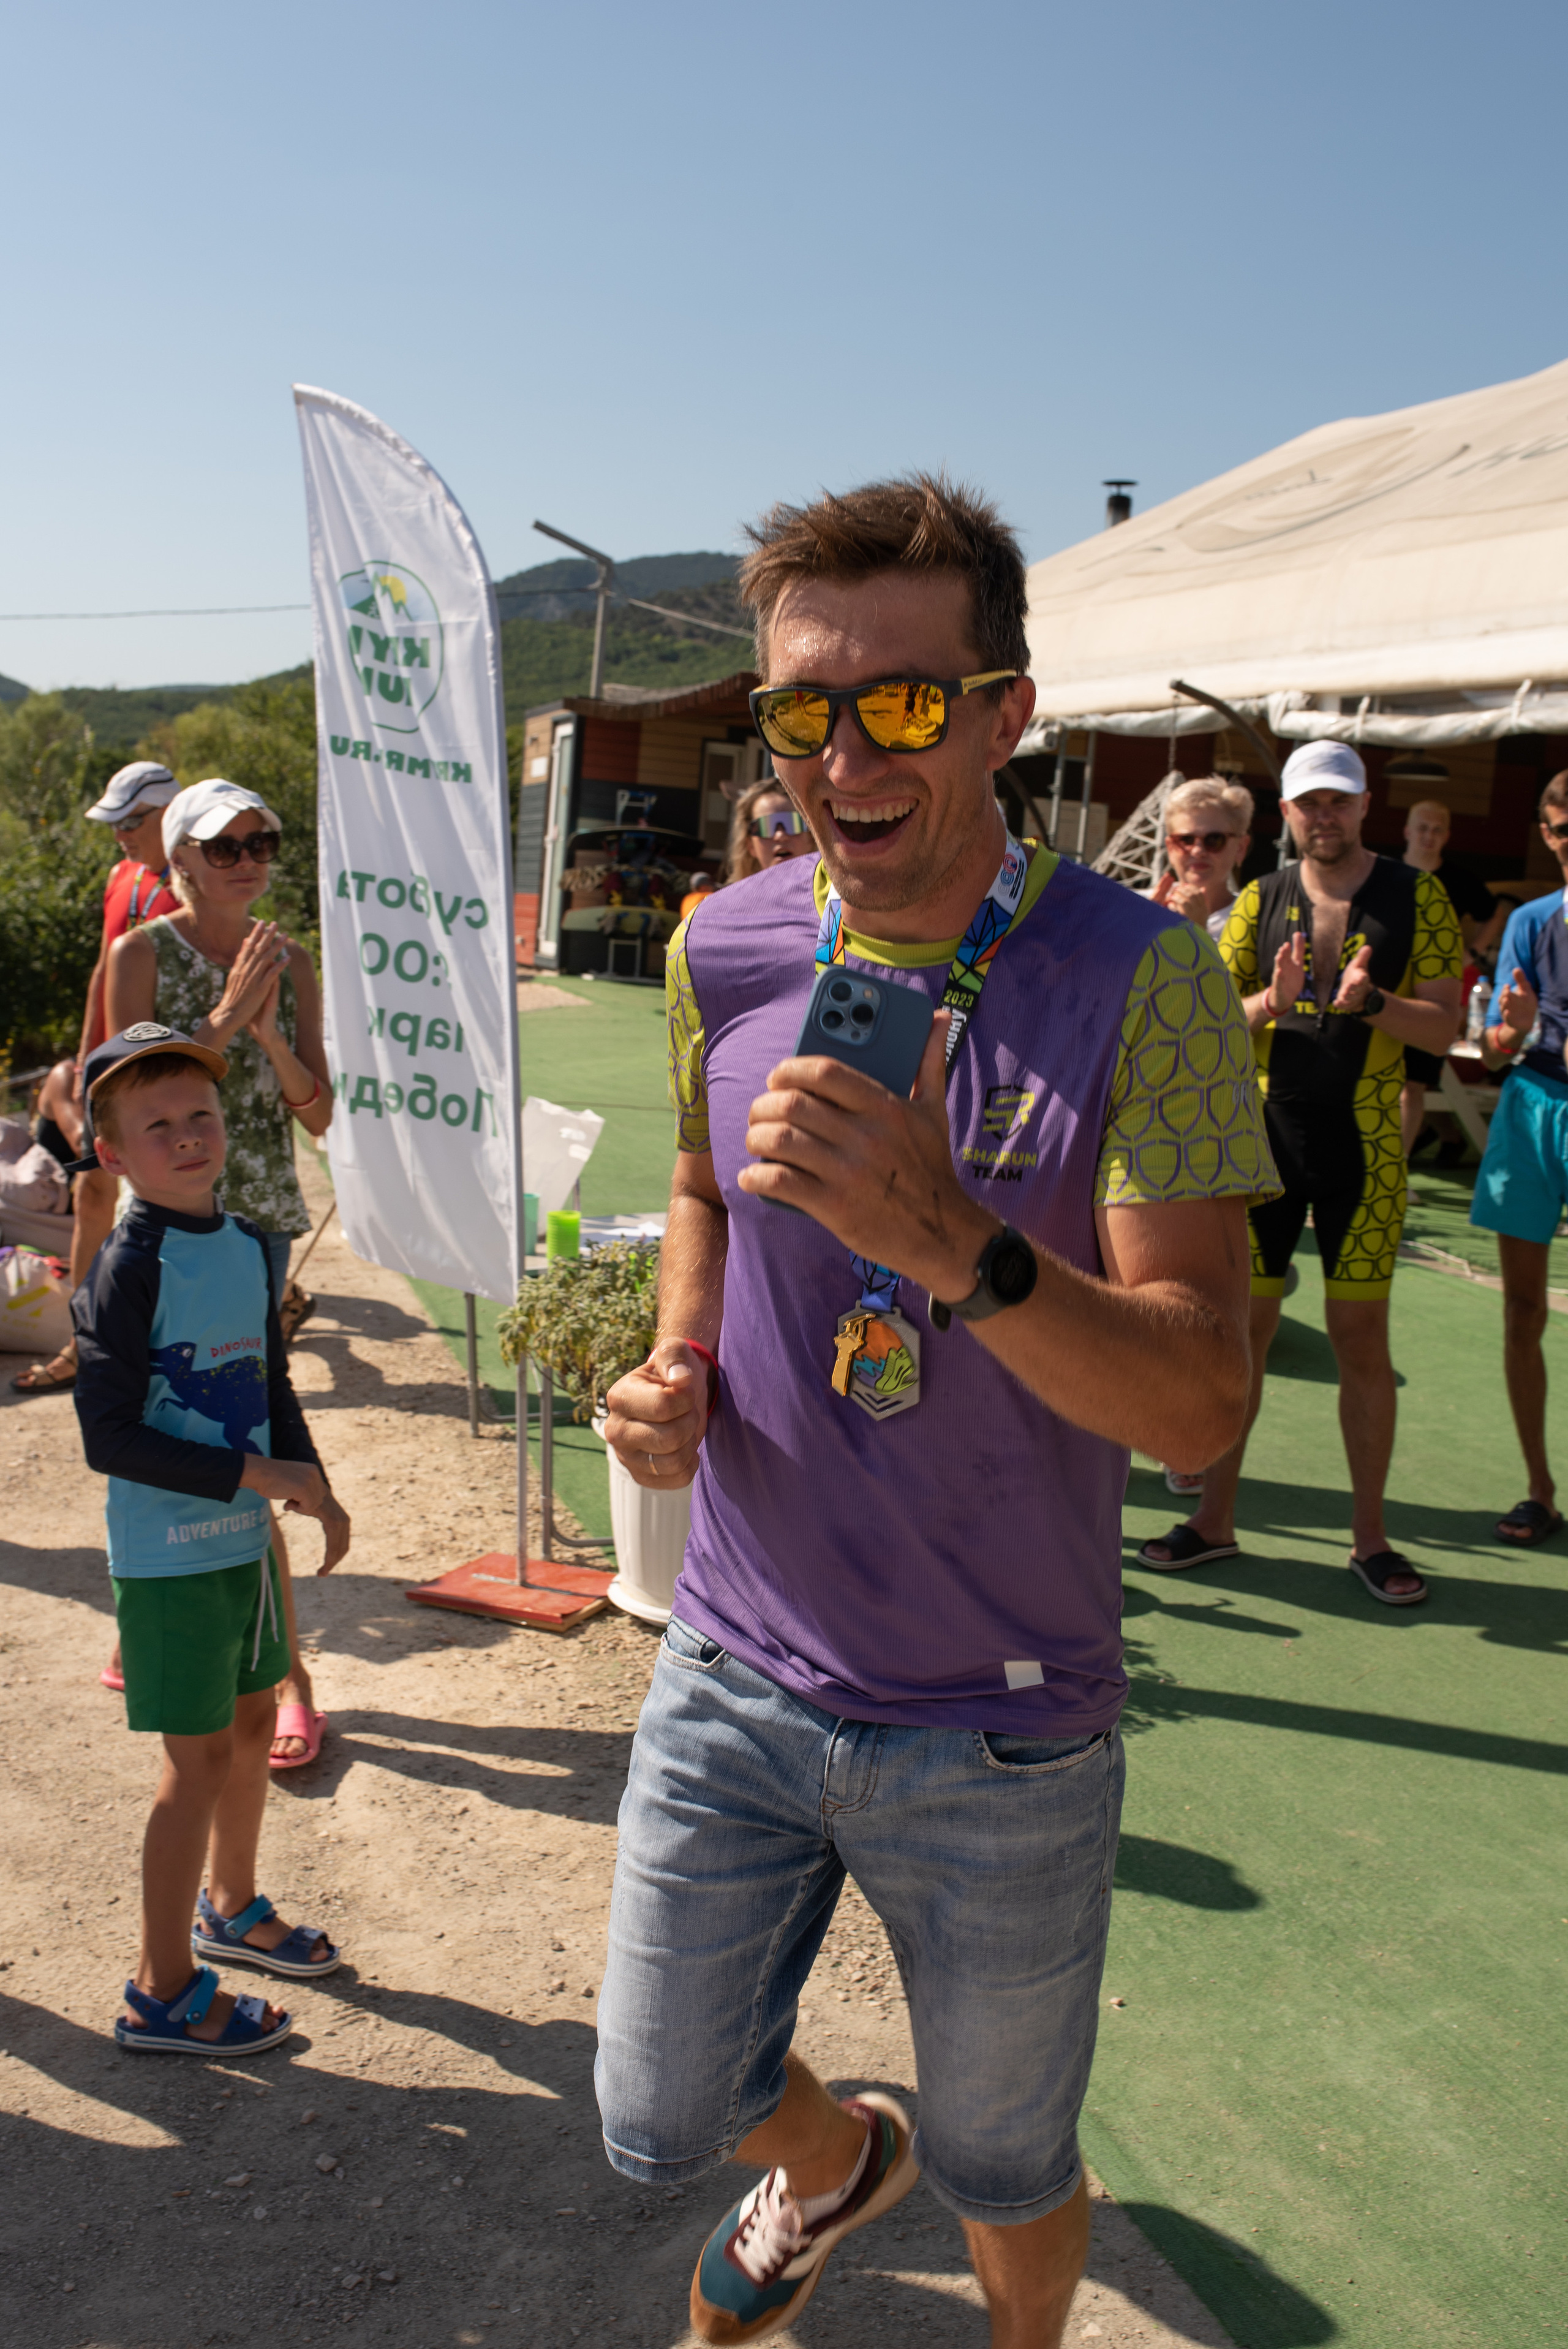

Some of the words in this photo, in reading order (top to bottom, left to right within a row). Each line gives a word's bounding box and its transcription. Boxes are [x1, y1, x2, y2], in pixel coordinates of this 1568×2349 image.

[944, 988, 974, 1008] 2023
[962, 1146, 1037, 1168] SHARUN
[973, 1165, 1023, 1182] TEAM
[210, 1336, 262, 1358] DINOSAUR
[166, 1510, 257, 1545] ADVENTURE
